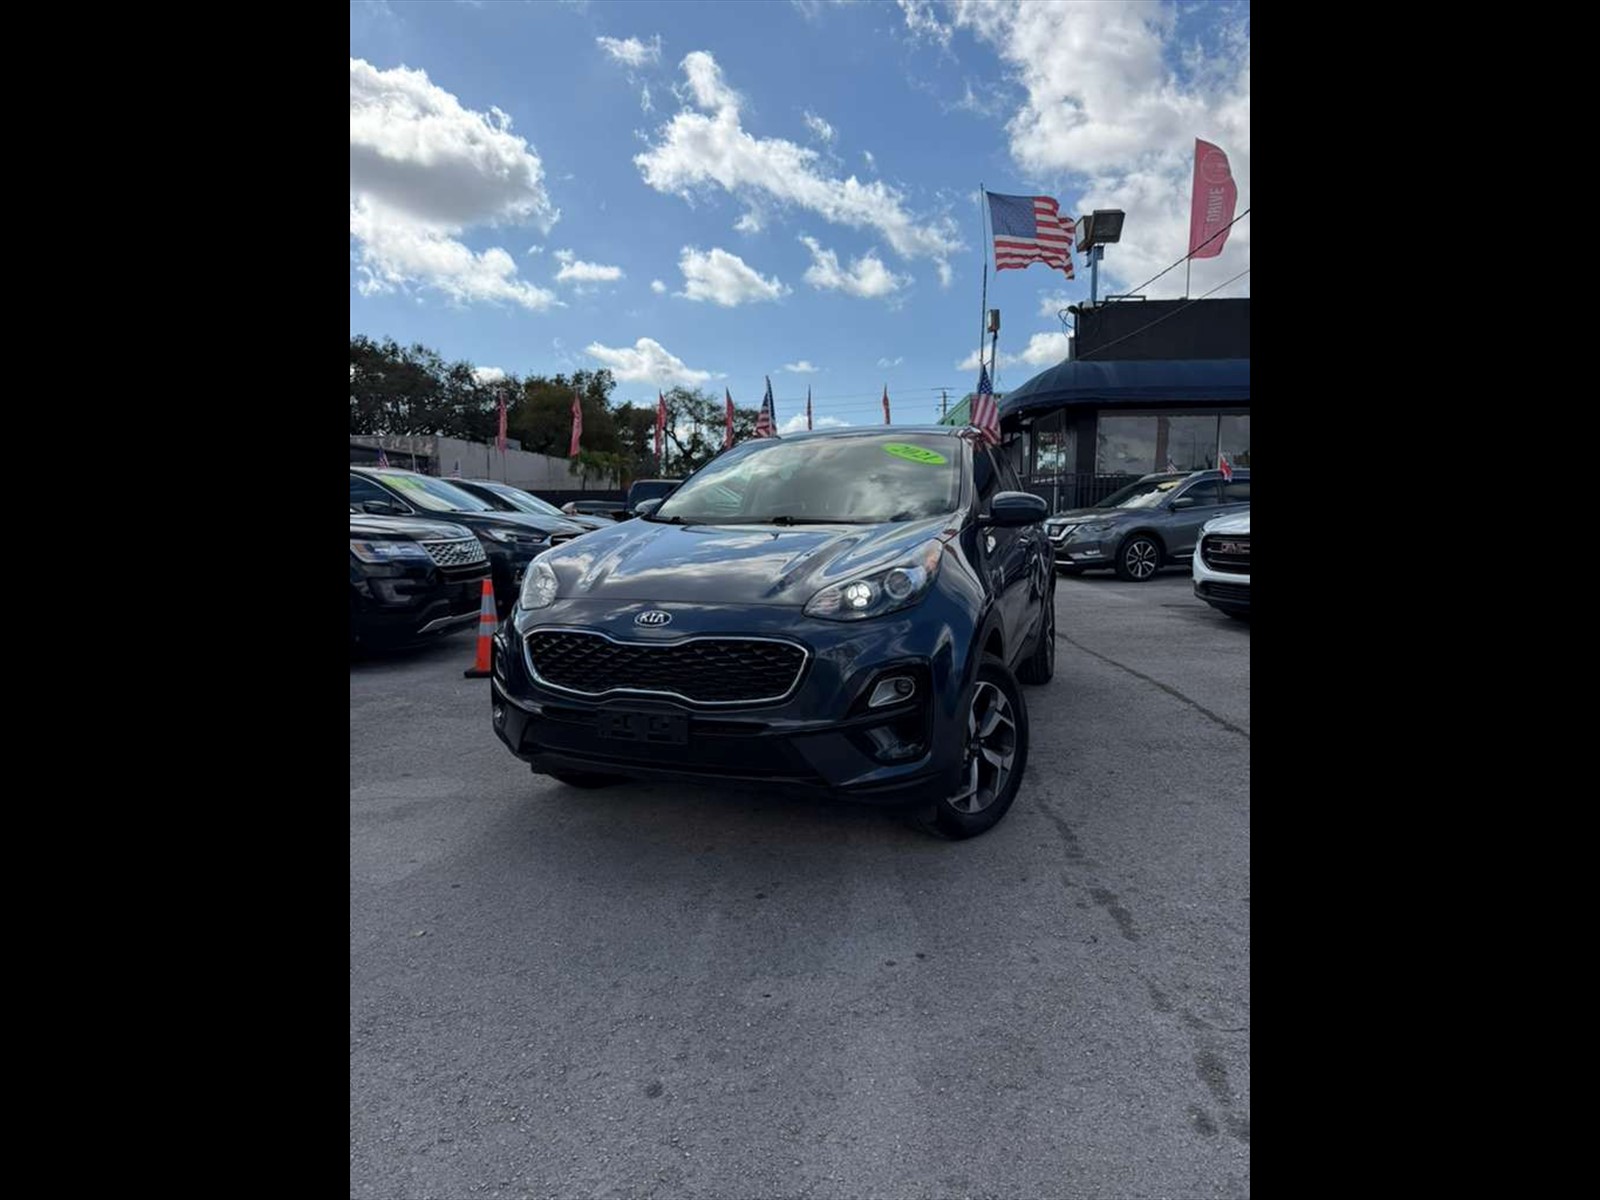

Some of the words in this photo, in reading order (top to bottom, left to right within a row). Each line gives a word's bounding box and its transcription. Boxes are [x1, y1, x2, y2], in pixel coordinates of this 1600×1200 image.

[1206, 187, 1224, 222] DRIVE
[889, 444, 940, 461] 2021
[639, 611, 665, 623] KIA
